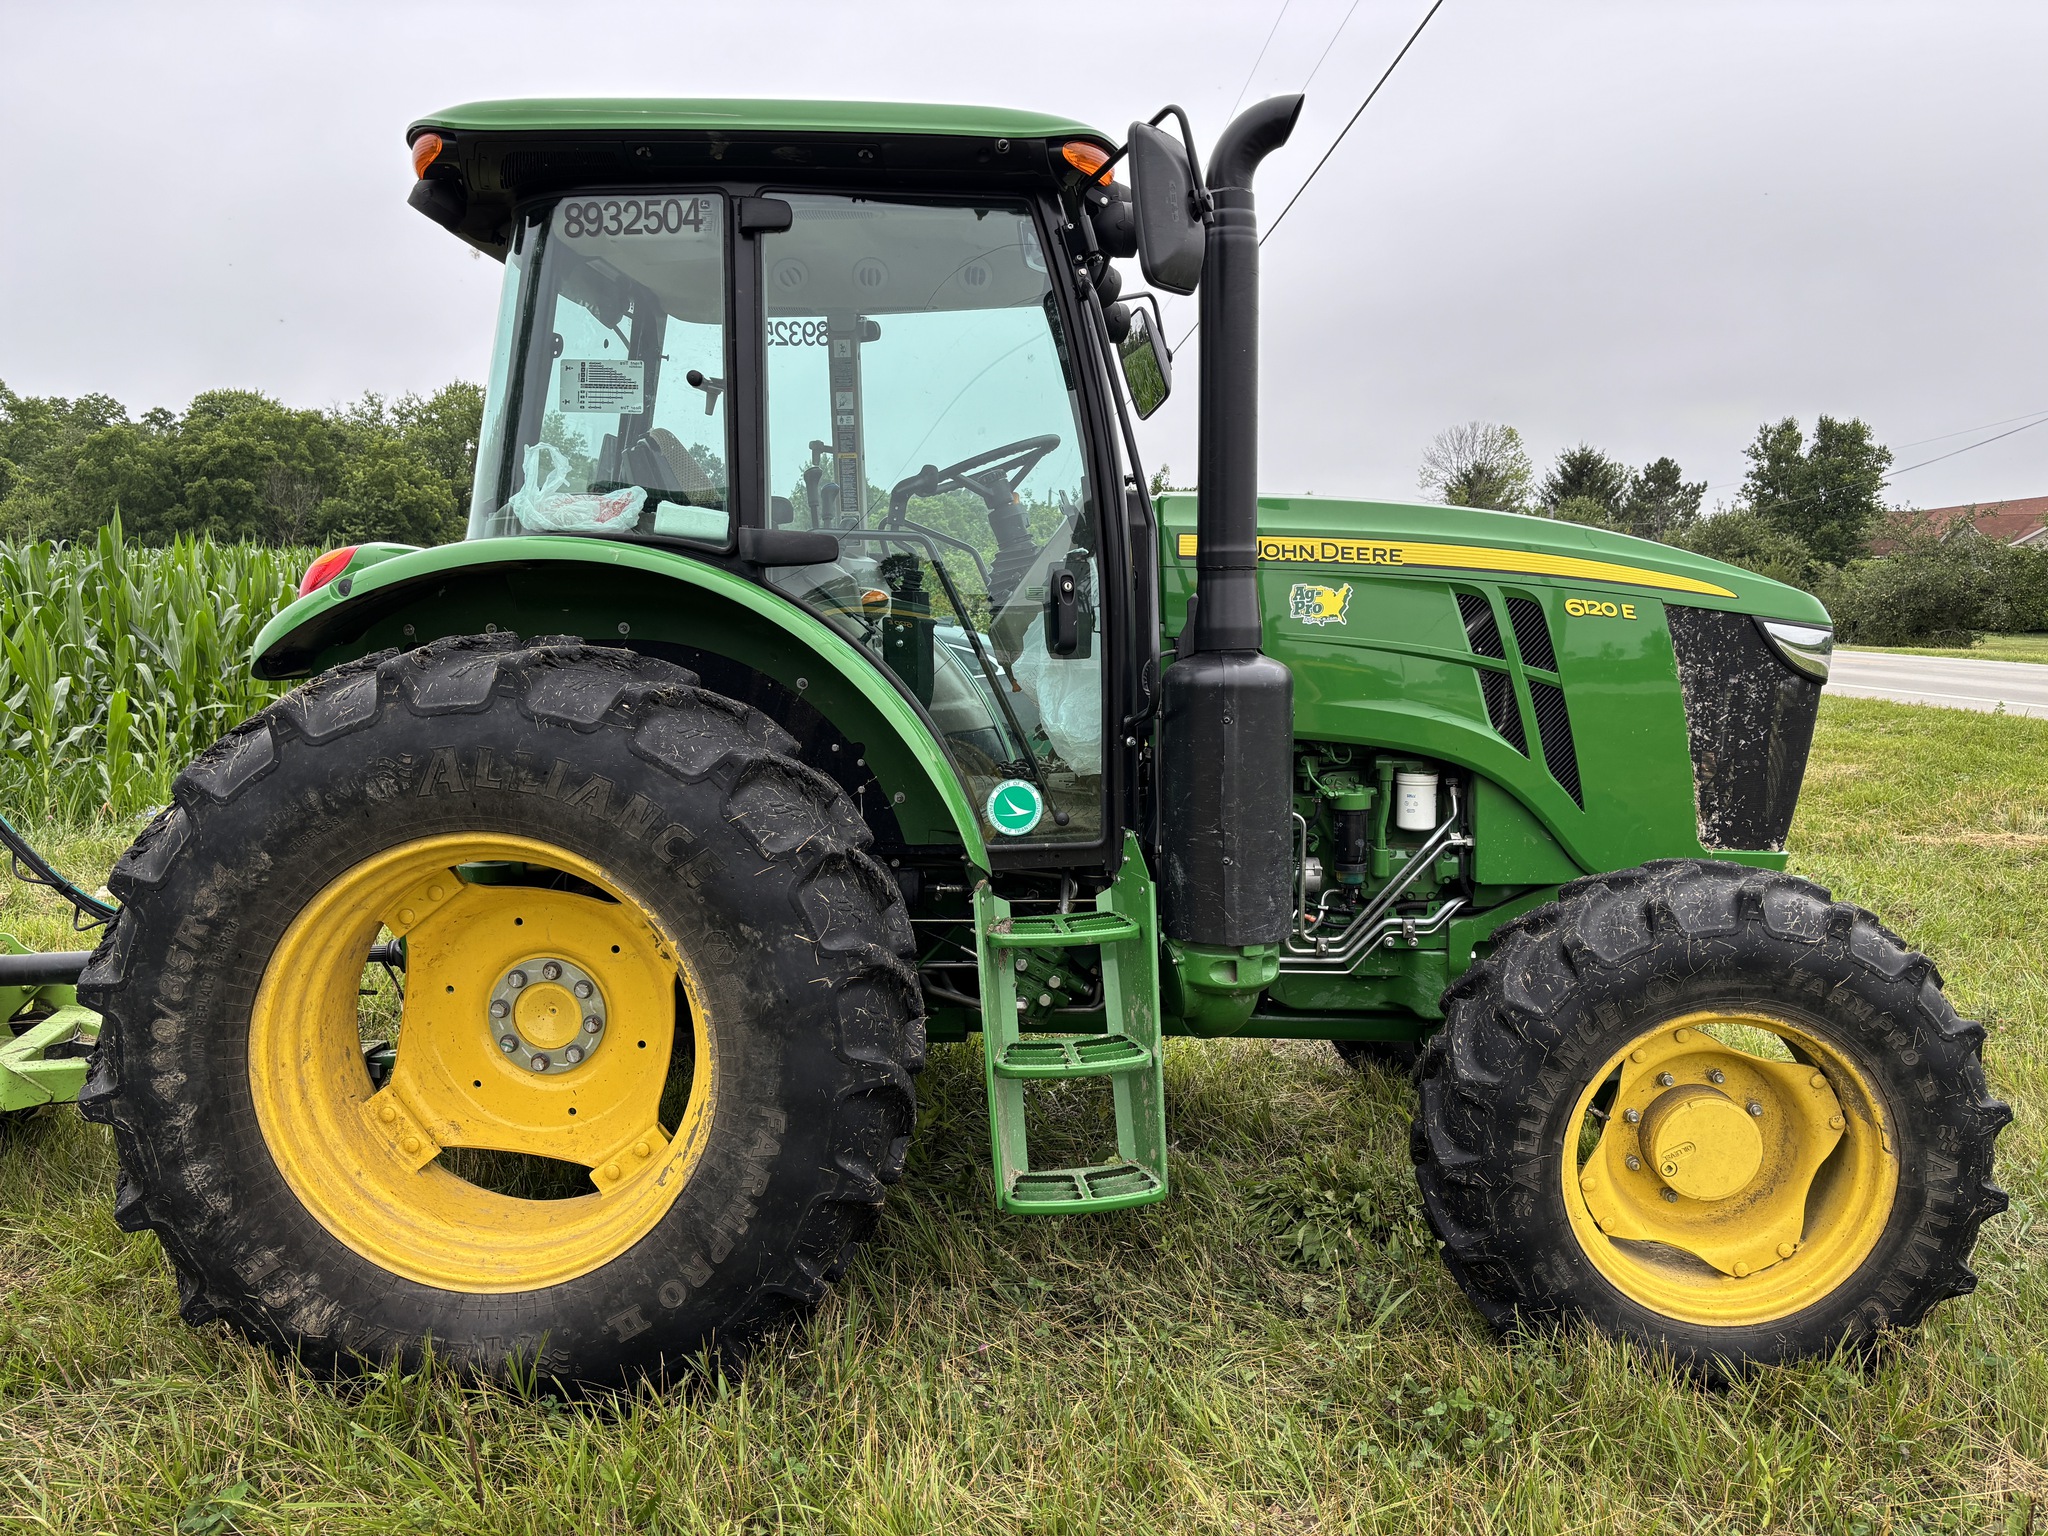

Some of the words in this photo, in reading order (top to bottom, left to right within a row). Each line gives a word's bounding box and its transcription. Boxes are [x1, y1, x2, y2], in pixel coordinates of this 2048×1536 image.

[564, 198, 704, 238] 8932504
[1257, 540, 1315, 560] JOHN
[1320, 542, 1403, 563] DEERE
[1293, 586, 1322, 603] Ag-
[1293, 600, 1323, 616] Pro
[1565, 598, 1618, 618] 6120
[1621, 603, 1638, 620] E
[288, 817, 341, 852] TUBELESS
[417, 745, 727, 889] ALLIANCE
[151, 861, 240, 1103] 460/85R34
[1789, 968, 1920, 1067] FARMPRO
[1512, 1000, 1621, 1193] ALLIANCE
[658, 1106, 788, 1309] FARMPRO
[1839, 1150, 1960, 1343] ALLIANCE
